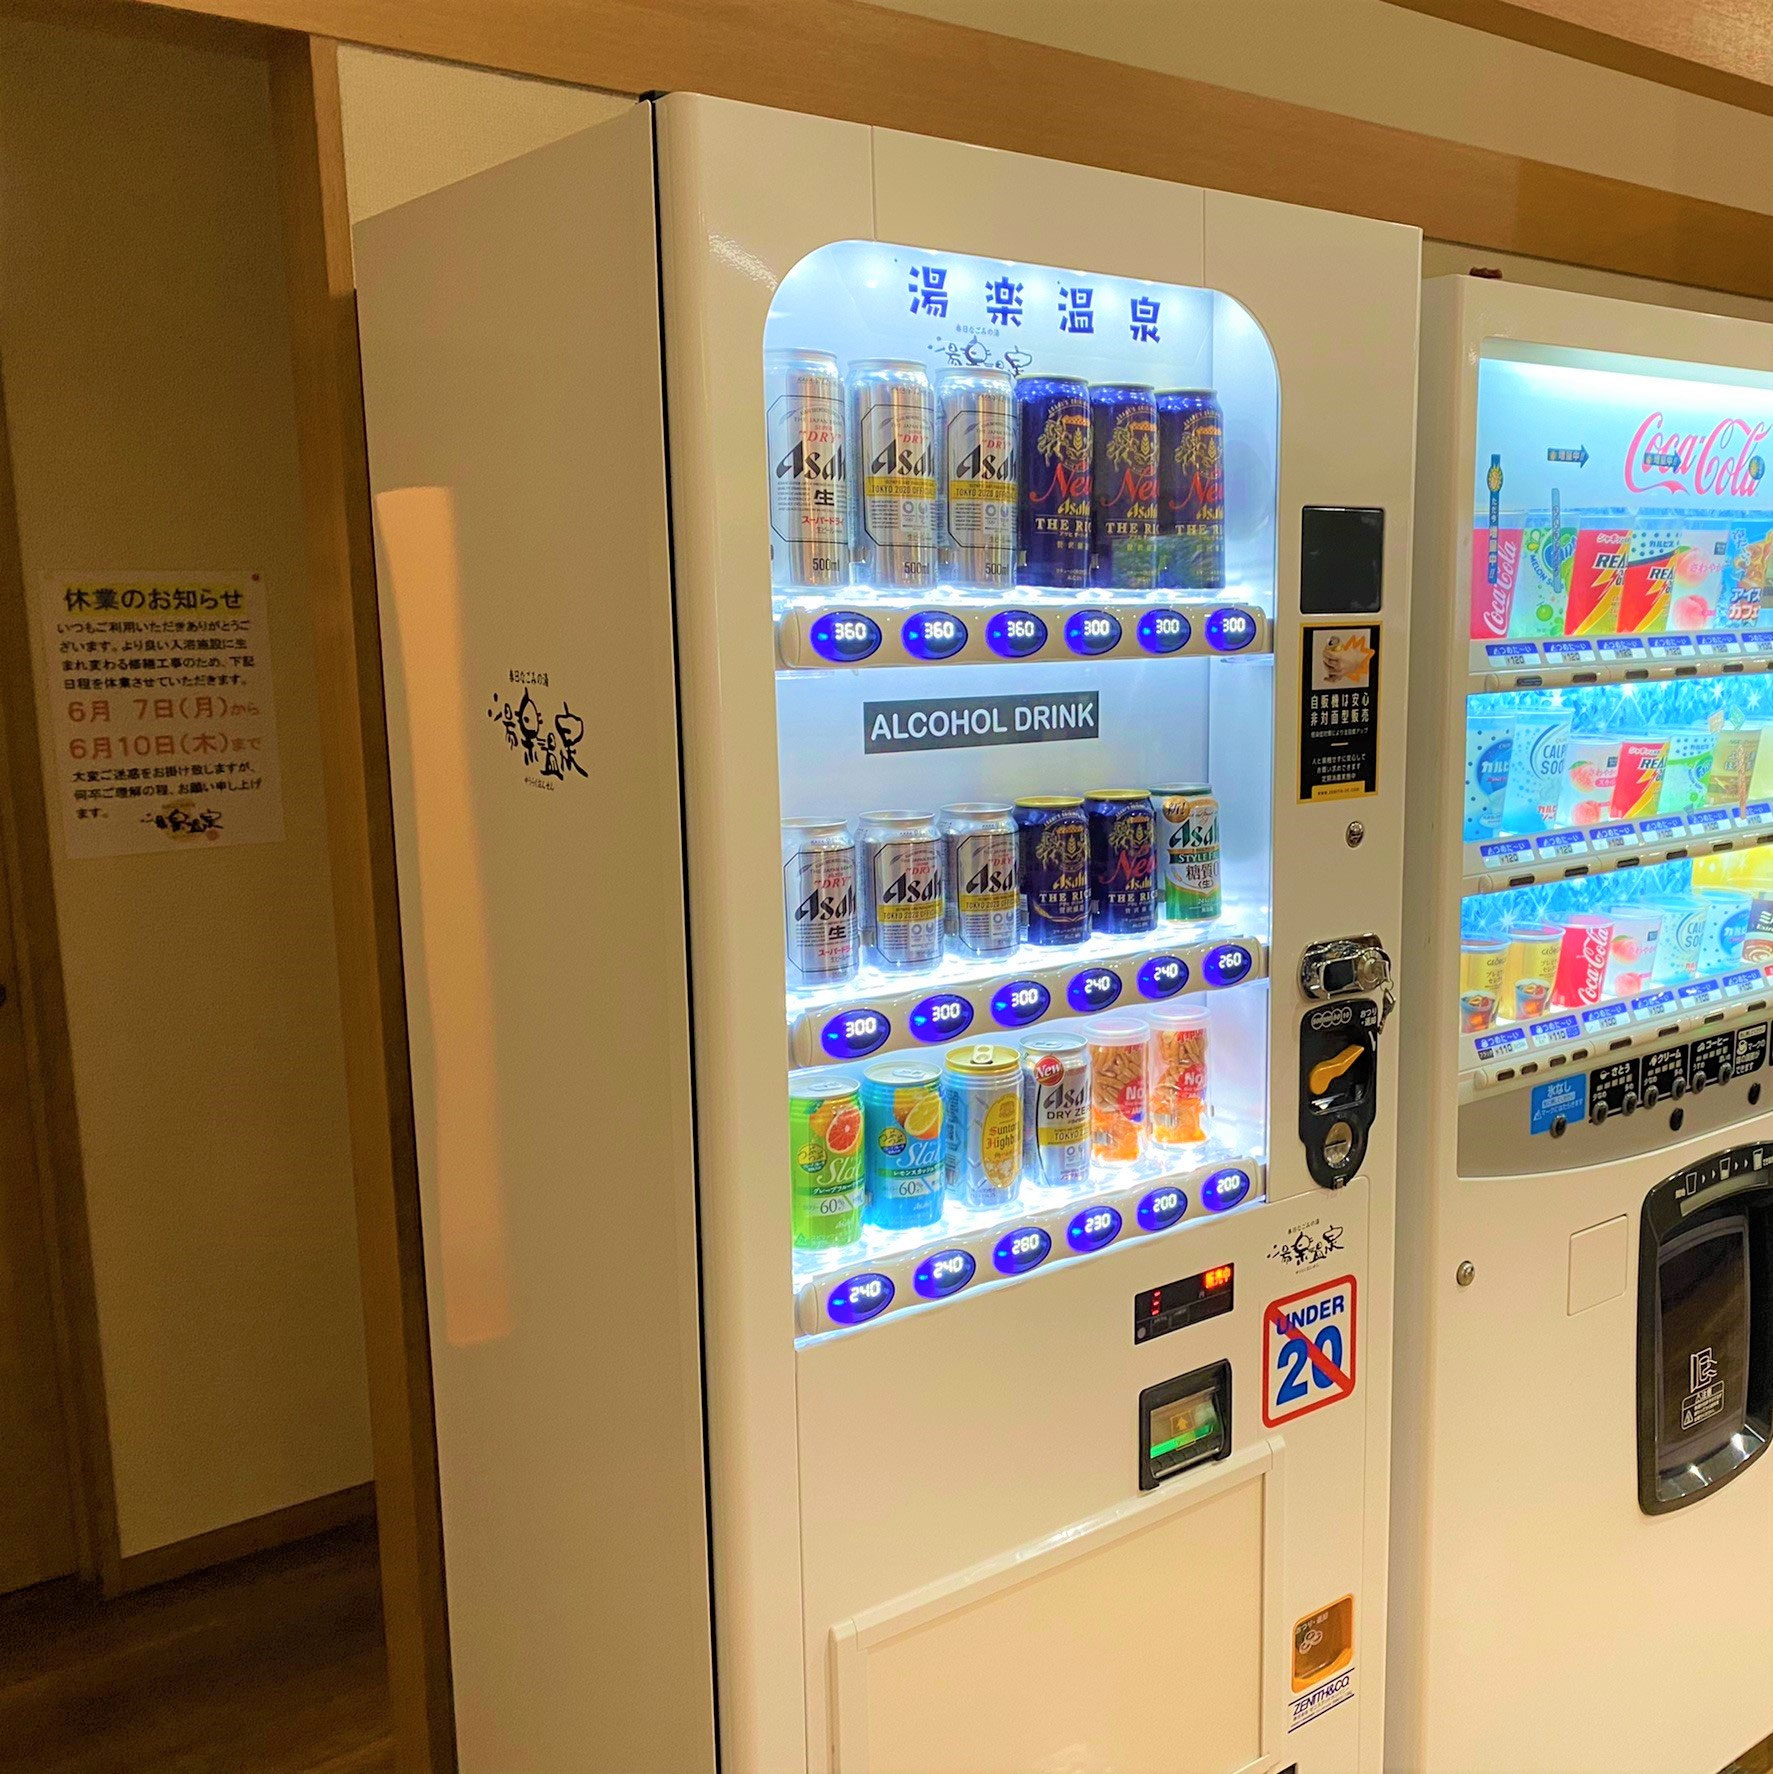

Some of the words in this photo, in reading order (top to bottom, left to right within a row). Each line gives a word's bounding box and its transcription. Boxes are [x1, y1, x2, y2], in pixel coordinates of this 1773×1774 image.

[1623, 411, 1772, 497] Coca-Cola
[814, 489, 835, 506] 生
[1035, 518, 1070, 531] THE
[1106, 522, 1139, 534] THE
[1175, 524, 1207, 536] THE
[64, 587, 243, 612] 休業のお知らせ
[1731, 588, 1761, 604] アイス
[834, 622, 866, 640] 360
[924, 621, 953, 639] 360
[1007, 620, 1034, 638] 360
[1084, 619, 1110, 636] 300
[1156, 619, 1180, 635] 300
[1222, 617, 1246, 633] 300
[1311, 692, 1370, 710] 自販機は安心
[870, 707, 1008, 742] ALCOHOL
[1014, 702, 1095, 732] DRINK
[1310, 708, 1369, 727] 非対面型販売
[1179, 853, 1207, 863] STYLE
[1039, 892, 1066, 903] THE
[1108, 893, 1135, 904] THE
[828, 926, 846, 940] 生
[1219, 952, 1242, 969] 260
[1154, 963, 1178, 981] 240
[1085, 975, 1110, 993] 240
[1012, 989, 1038, 1007] 300
[932, 1003, 960, 1021] 300
[845, 1017, 877, 1038] 300
[1706, 1037, 1729, 1049] コーヒー
[1657, 1049, 1681, 1063] クリーム
[1036, 1063, 1061, 1079] New
[1611, 1063, 1631, 1076] さとう
[1547, 1081, 1571, 1099] 氷なし
[1047, 1109, 1071, 1120] DRY
[1217, 1175, 1240, 1193] 200
[1153, 1194, 1177, 1213] 200
[1085, 1213, 1111, 1233] 230
[1012, 1233, 1039, 1255] 280
[933, 1257, 963, 1278] 240
[850, 1279, 881, 1300] 240
[1276, 1294, 1345, 1336] UNDER
[1276, 1325, 1343, 1407] 20
